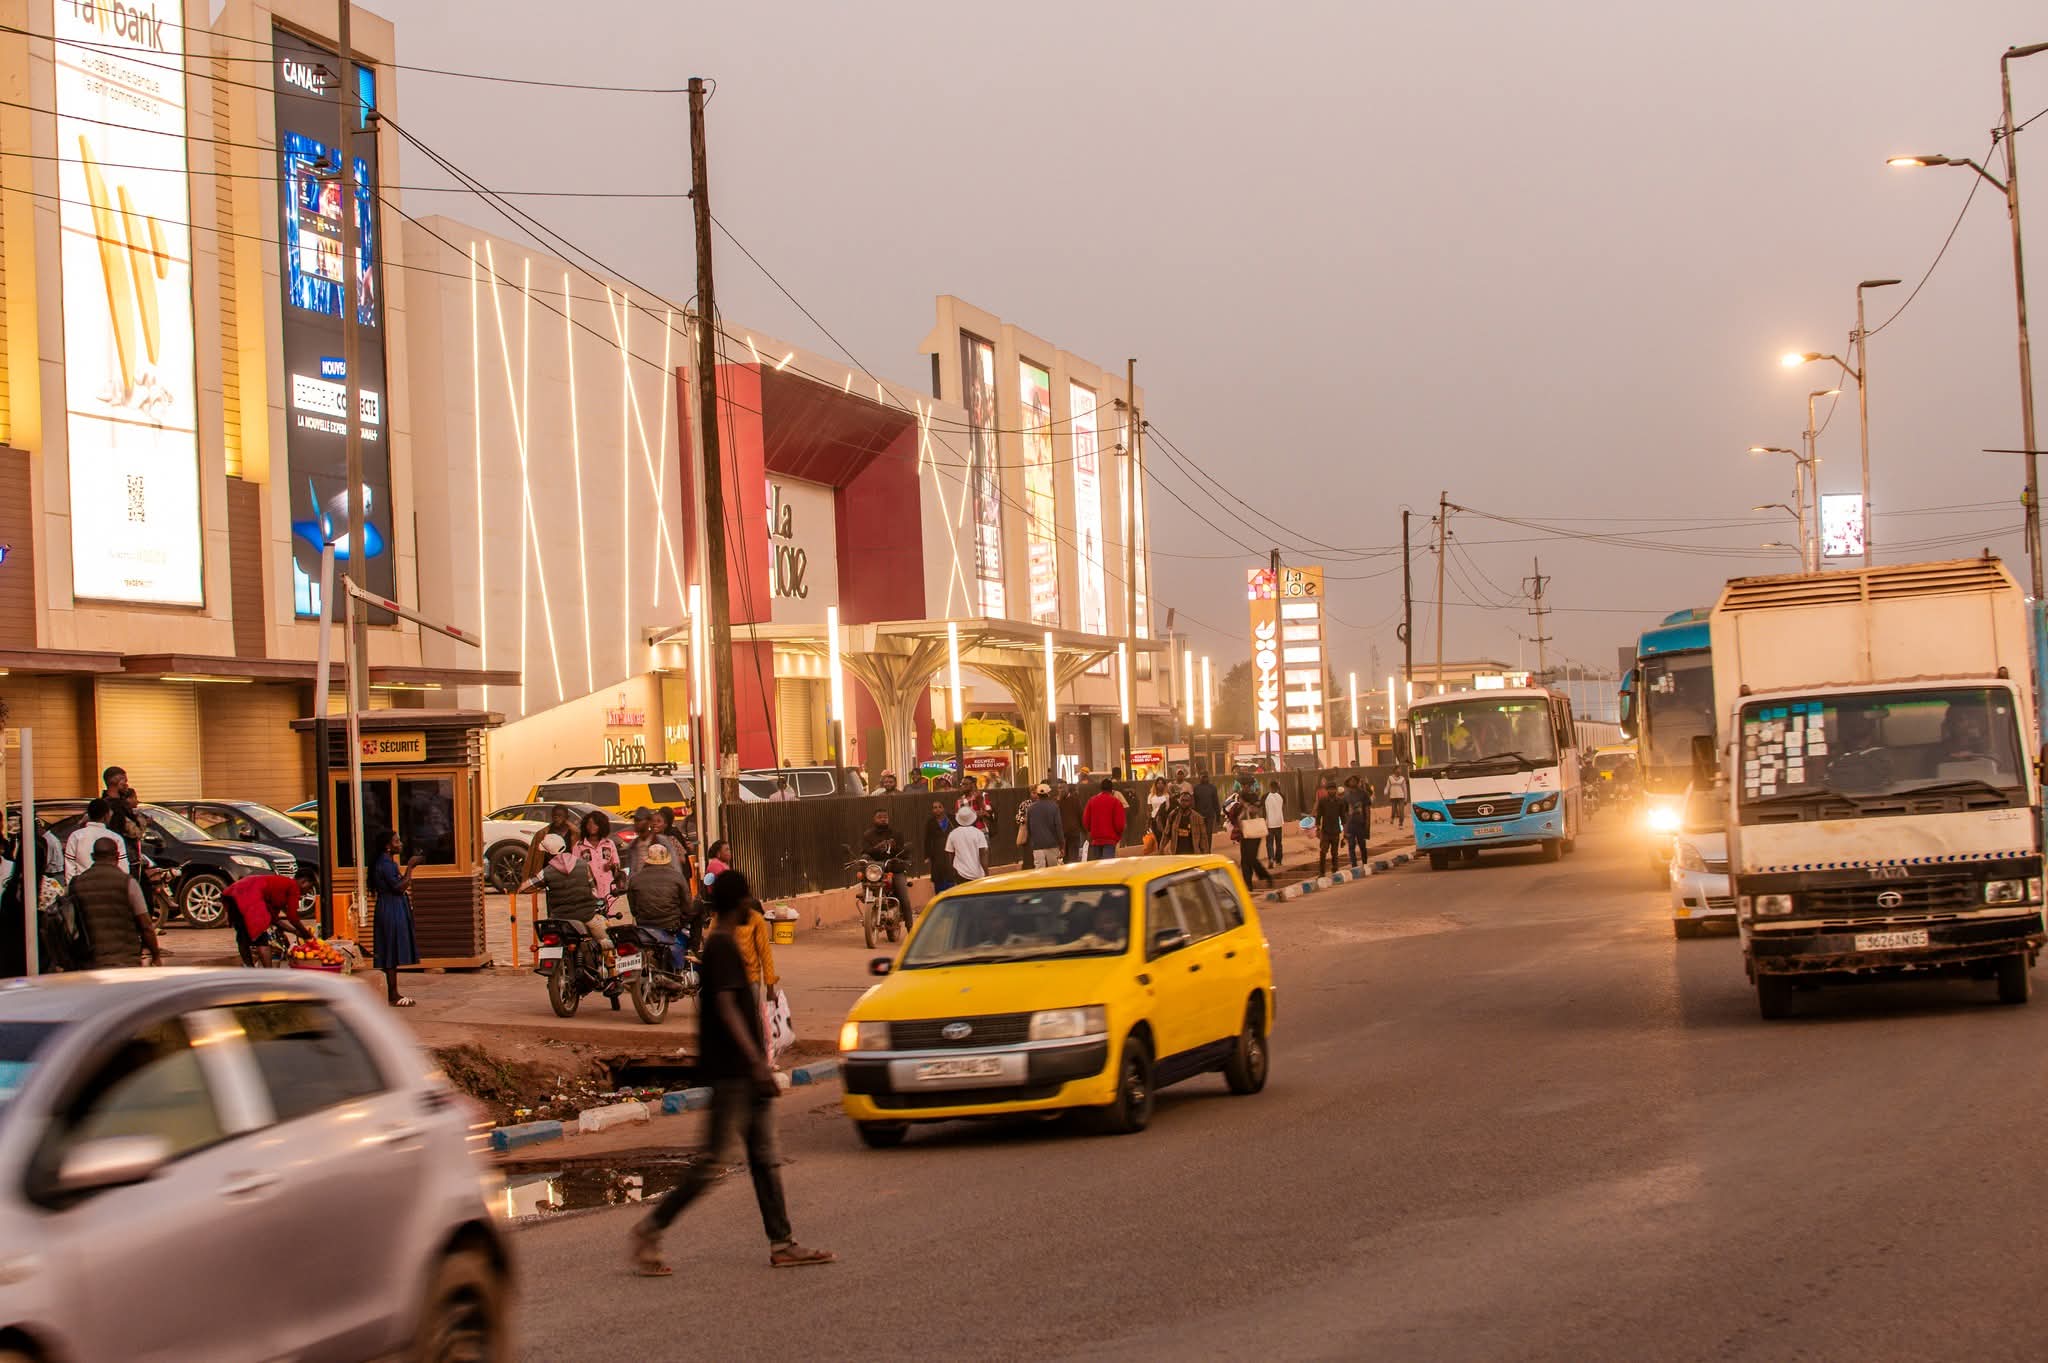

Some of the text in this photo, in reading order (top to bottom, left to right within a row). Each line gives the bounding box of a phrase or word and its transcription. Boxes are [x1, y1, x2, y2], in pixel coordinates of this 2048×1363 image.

[771, 485, 793, 539] La
[379, 738, 420, 753] SÉCURITÉ
[1867, 866, 1909, 879] TATA
